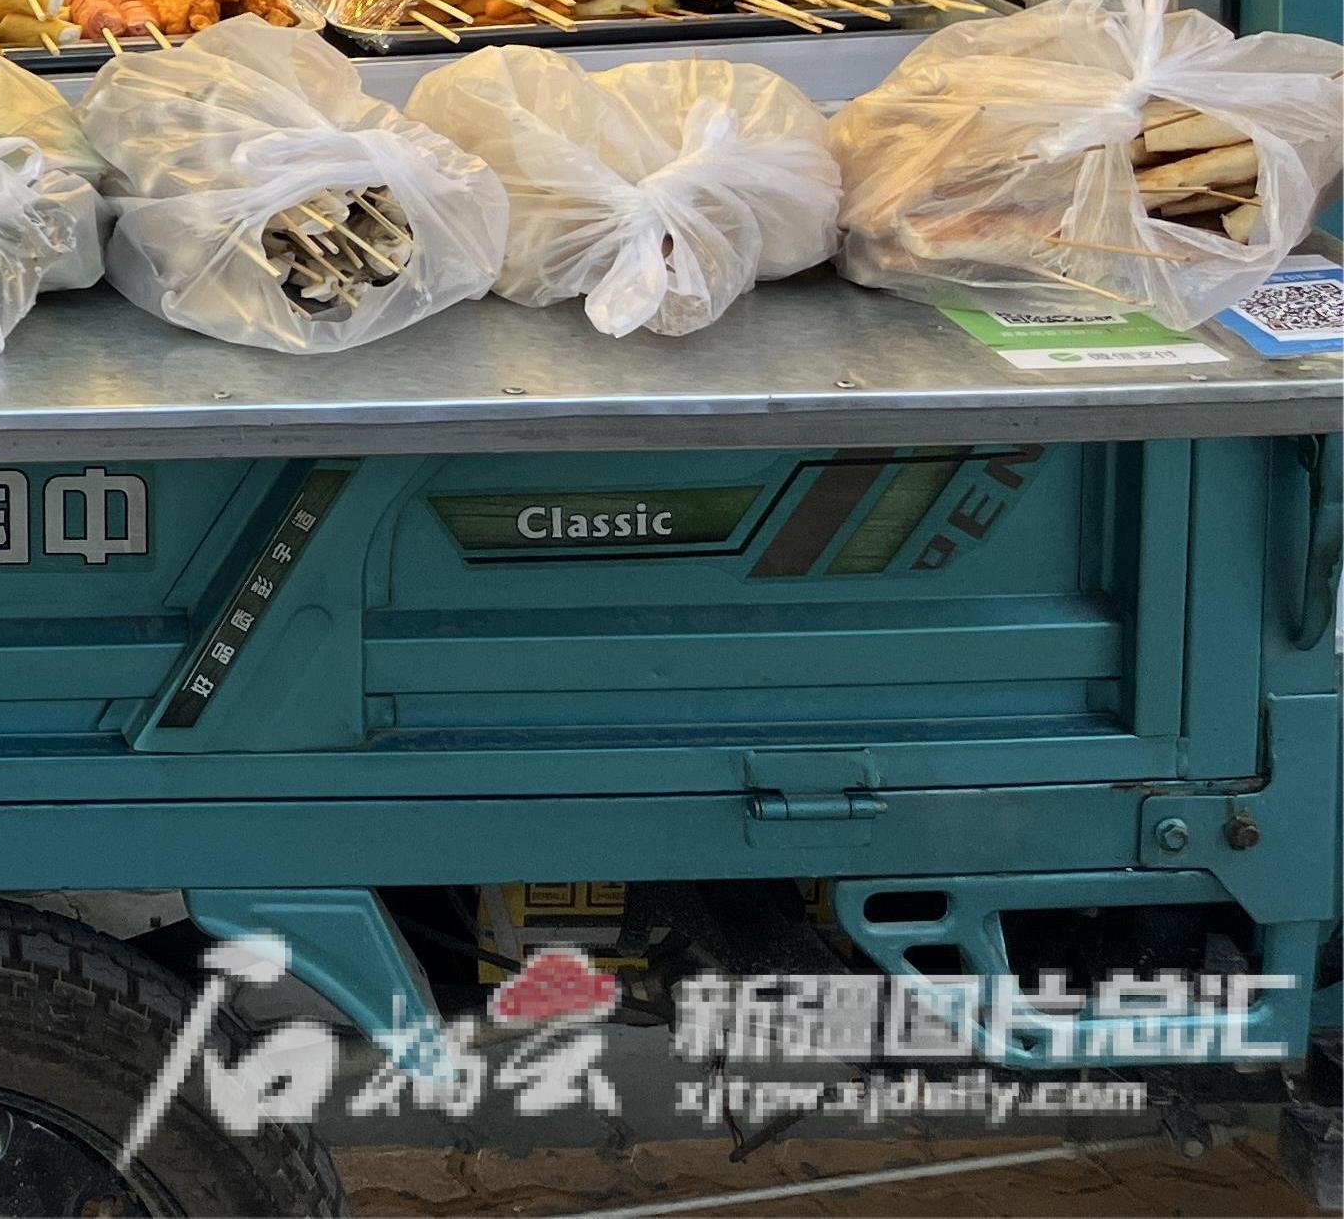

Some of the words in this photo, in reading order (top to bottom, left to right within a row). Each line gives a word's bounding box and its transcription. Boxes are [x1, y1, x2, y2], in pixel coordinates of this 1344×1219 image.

[1087, 349, 1178, 362] 微信支付
[516, 503, 674, 541] Classic
